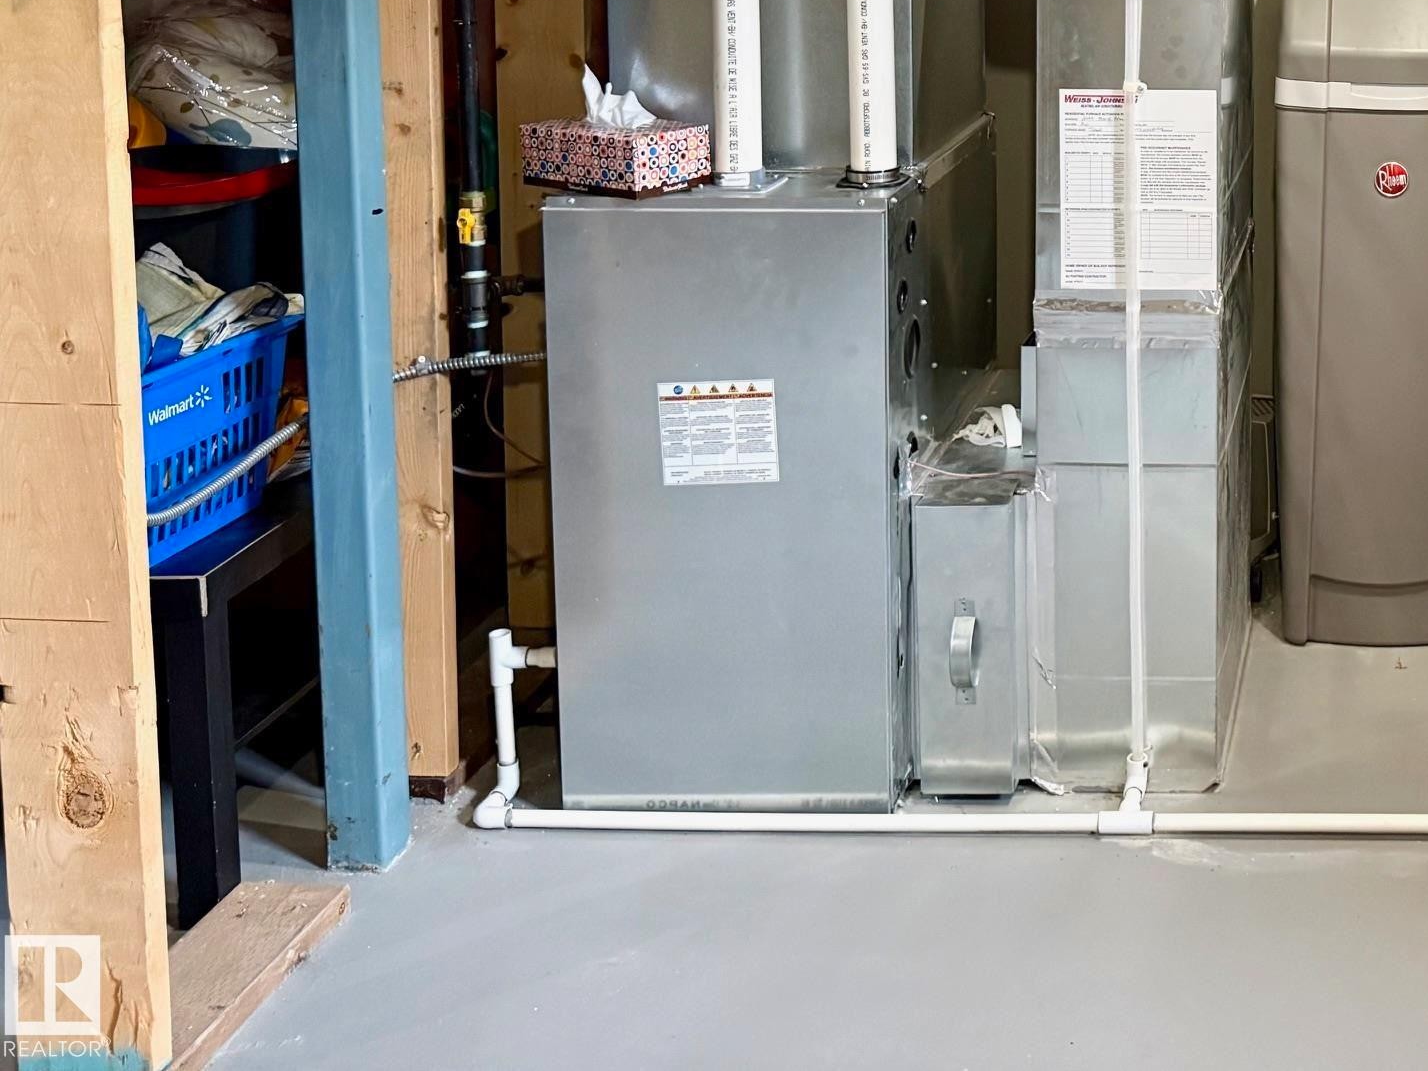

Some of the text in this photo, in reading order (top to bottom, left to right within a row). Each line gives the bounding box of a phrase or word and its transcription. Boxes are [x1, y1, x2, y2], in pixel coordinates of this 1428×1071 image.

[728, 67, 738, 76] DE
[728, 78, 738, 92] MISE
[729, 120, 739, 138] LIBRE
[729, 140, 739, 151] DES
[1378, 164, 1407, 192] Rheem
[148, 394, 195, 426] Walmart
